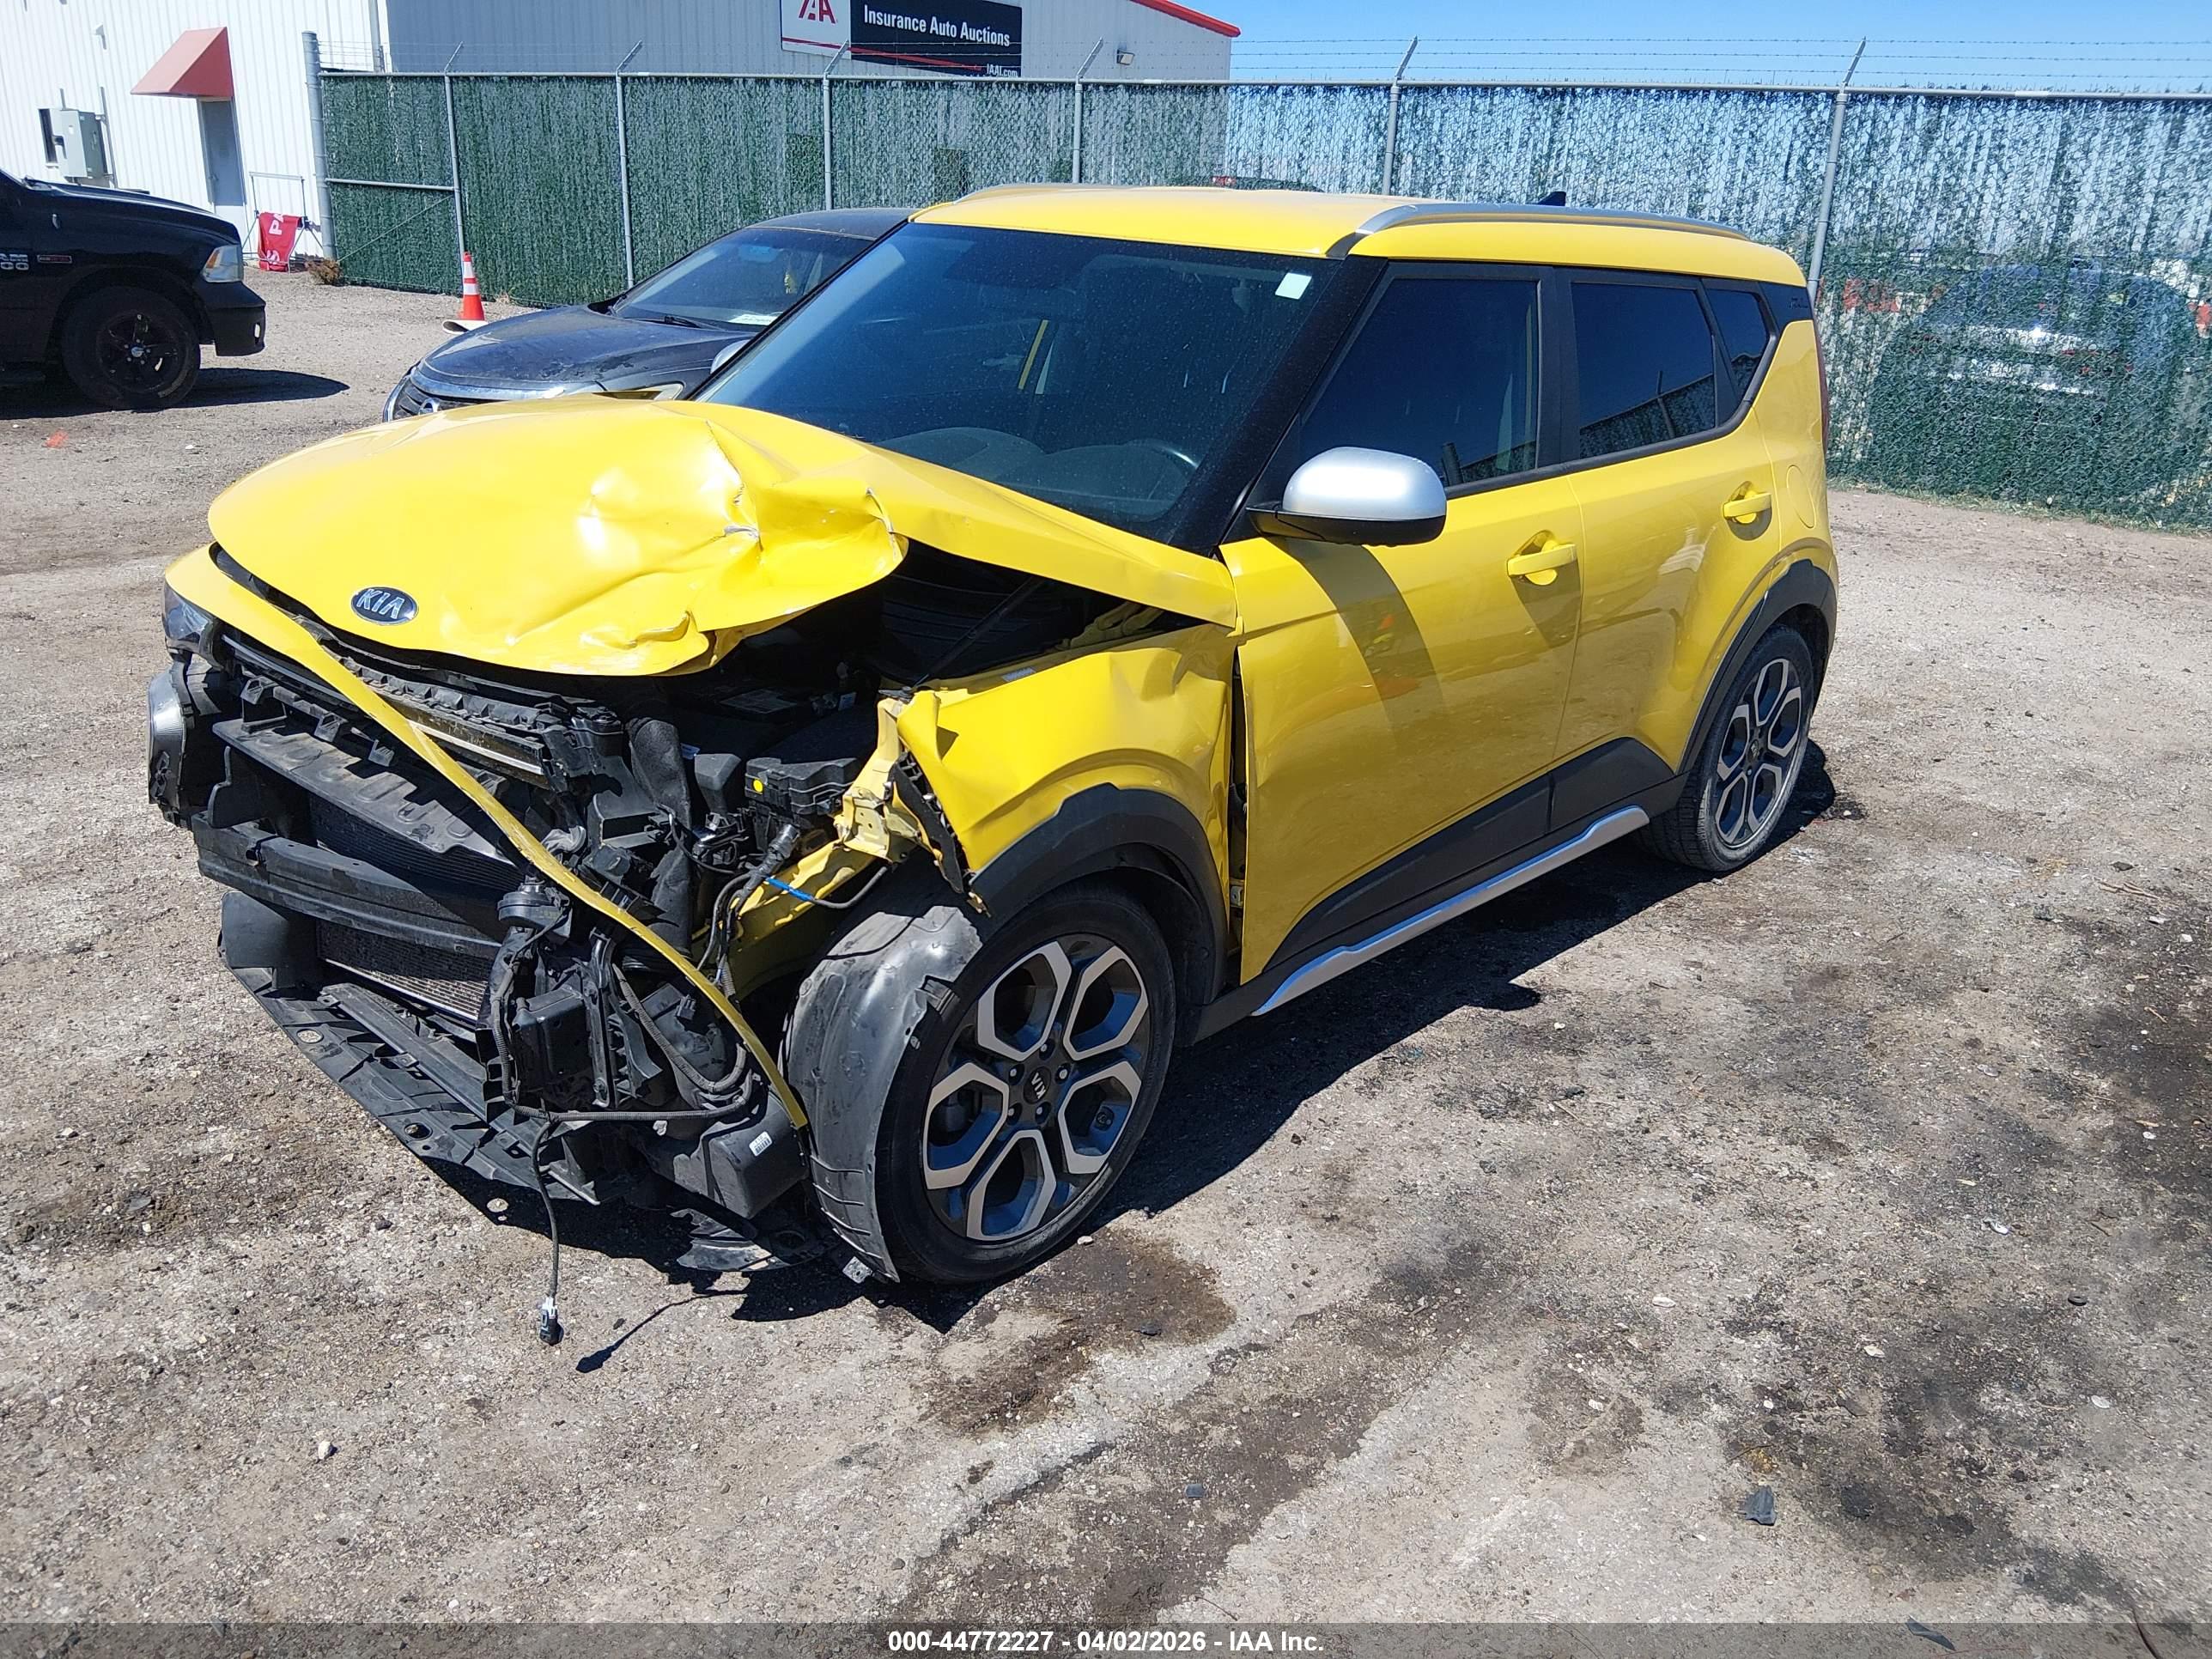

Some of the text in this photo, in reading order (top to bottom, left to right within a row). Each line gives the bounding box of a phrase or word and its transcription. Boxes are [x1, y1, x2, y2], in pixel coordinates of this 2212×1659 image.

[864, 4, 1011, 47] Insurance Auto Auctions
[356, 588, 405, 619] KIA
